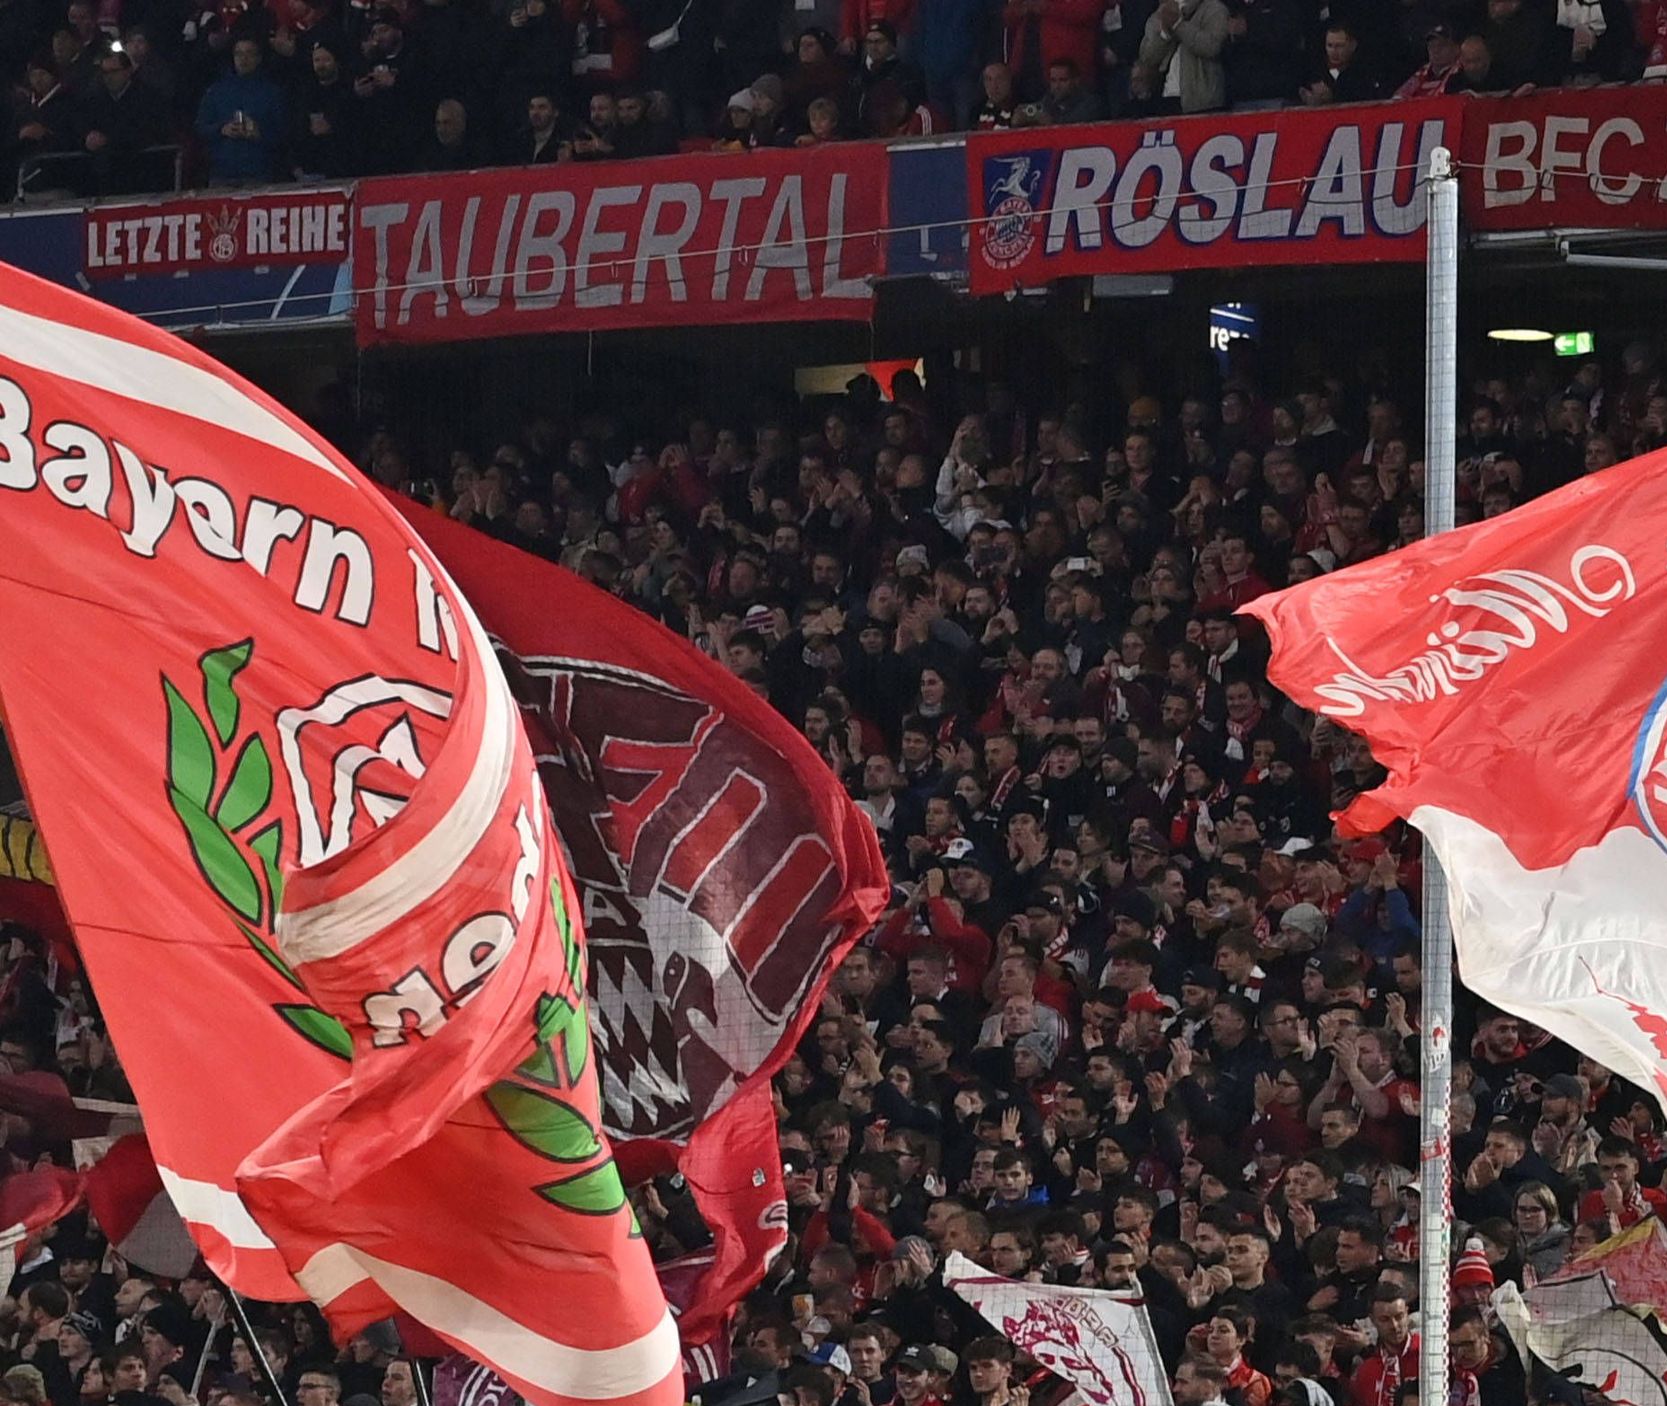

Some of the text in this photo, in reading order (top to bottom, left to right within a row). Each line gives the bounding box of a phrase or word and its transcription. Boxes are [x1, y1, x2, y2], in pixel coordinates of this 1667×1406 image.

[1045, 118, 1446, 254] RÖSLAU
[1482, 113, 1645, 209] BFC
[87, 203, 345, 267] LETZTE REIHE
[361, 172, 873, 332] TAUBERTAL
